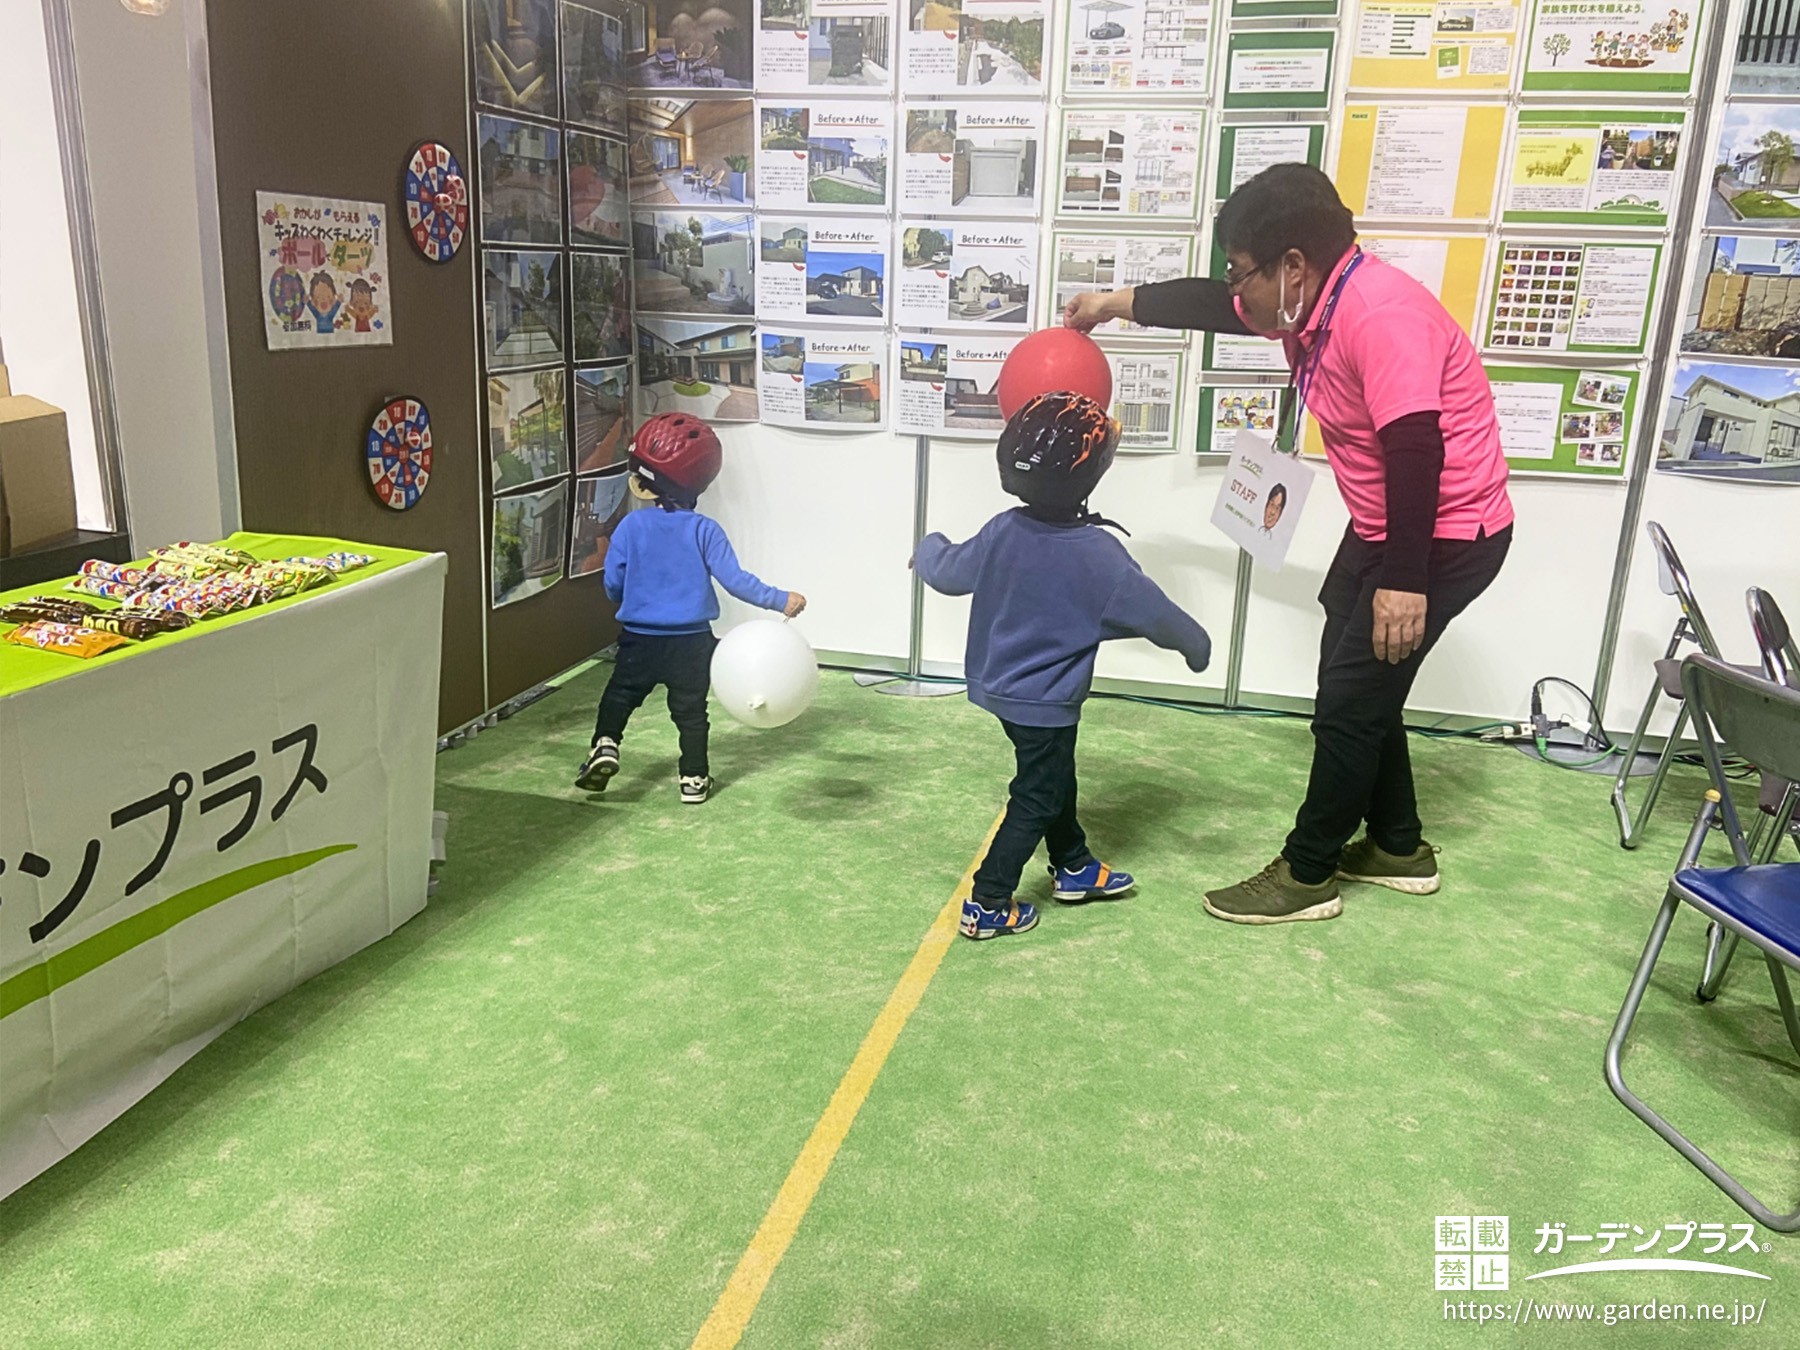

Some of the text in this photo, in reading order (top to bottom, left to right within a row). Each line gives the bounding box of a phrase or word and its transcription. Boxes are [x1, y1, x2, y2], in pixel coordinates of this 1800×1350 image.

[818, 113, 878, 124] Before After
[966, 115, 1030, 126] Before After
[815, 230, 874, 242] Before After
[962, 234, 1023, 245] Before After
[281, 240, 326, 266] ボール
[334, 243, 372, 268] ダーツ
[811, 342, 871, 353] Before After
[956, 350, 1009, 361] Before Aft
[1231, 479, 1257, 504] STAFF
[0, 723, 328, 943] ンプラス
